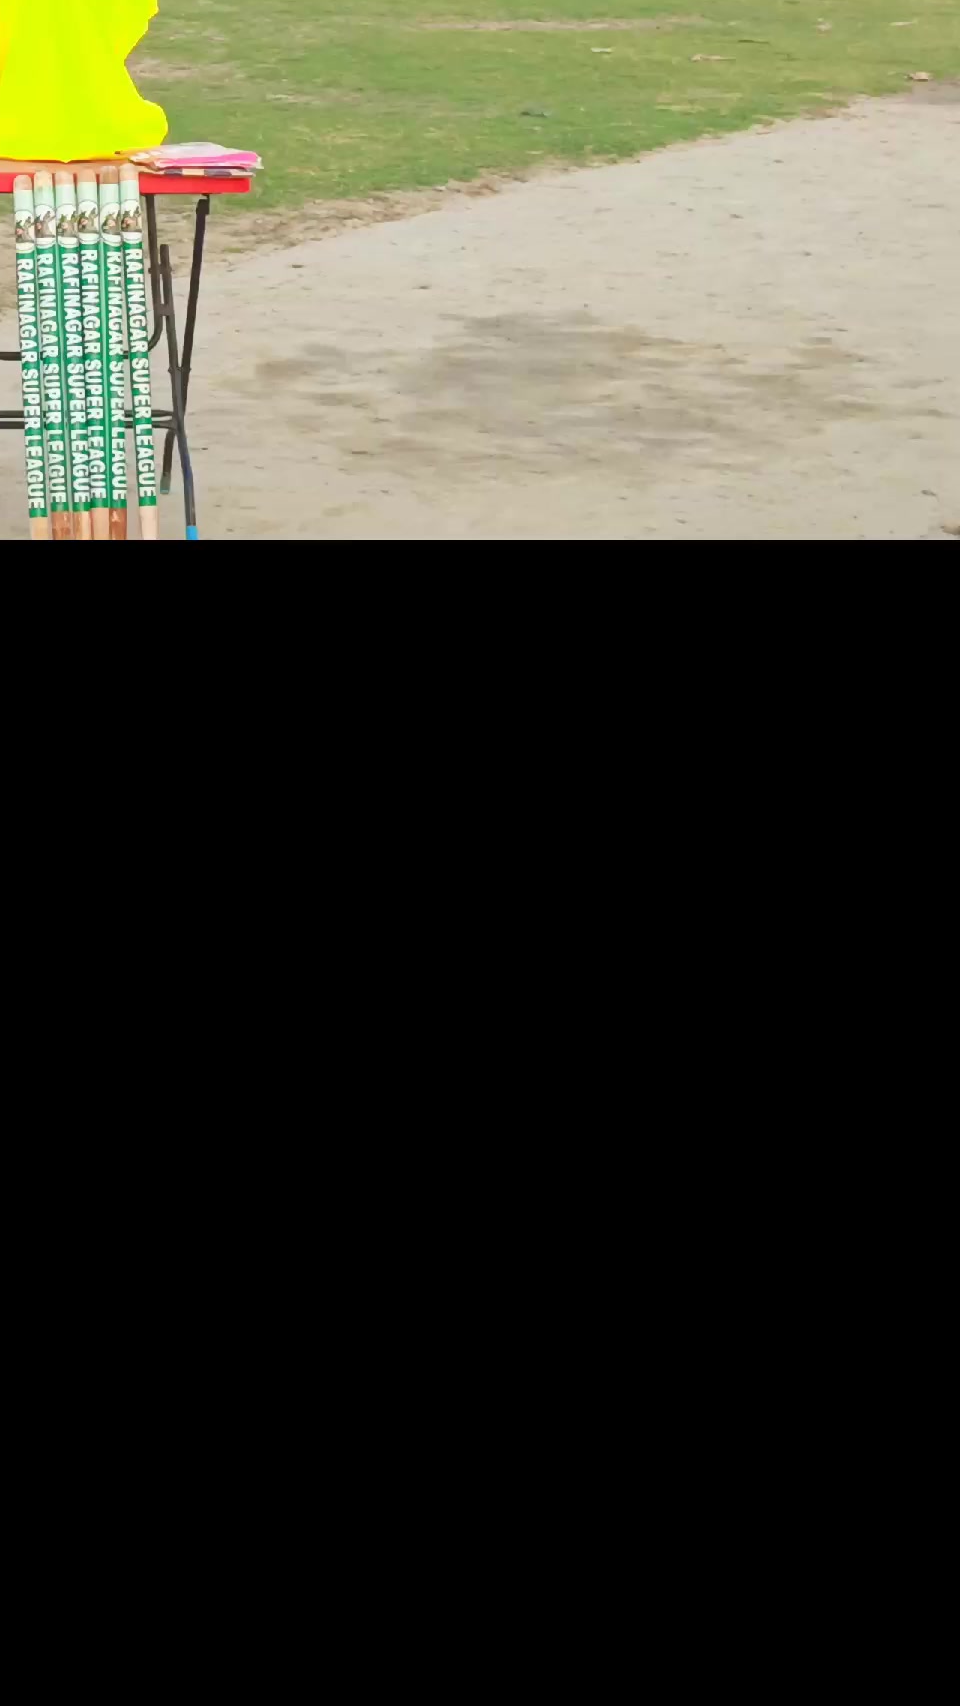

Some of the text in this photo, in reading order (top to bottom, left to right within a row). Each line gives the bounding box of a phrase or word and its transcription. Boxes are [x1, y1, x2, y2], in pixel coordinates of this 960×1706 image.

[17, 258, 45, 509] RAFINAGAR SUPER LEAGUE
[37, 253, 67, 503] RAFINAGAR SUPER LEAGUE
[61, 253, 90, 503] RAFINAGAR SUPER LEAGUE
[81, 249, 107, 499] RAFINAGAR SUPER LEAGUE
[125, 248, 157, 498] RAFINAGAR SUPER LEAGUE
